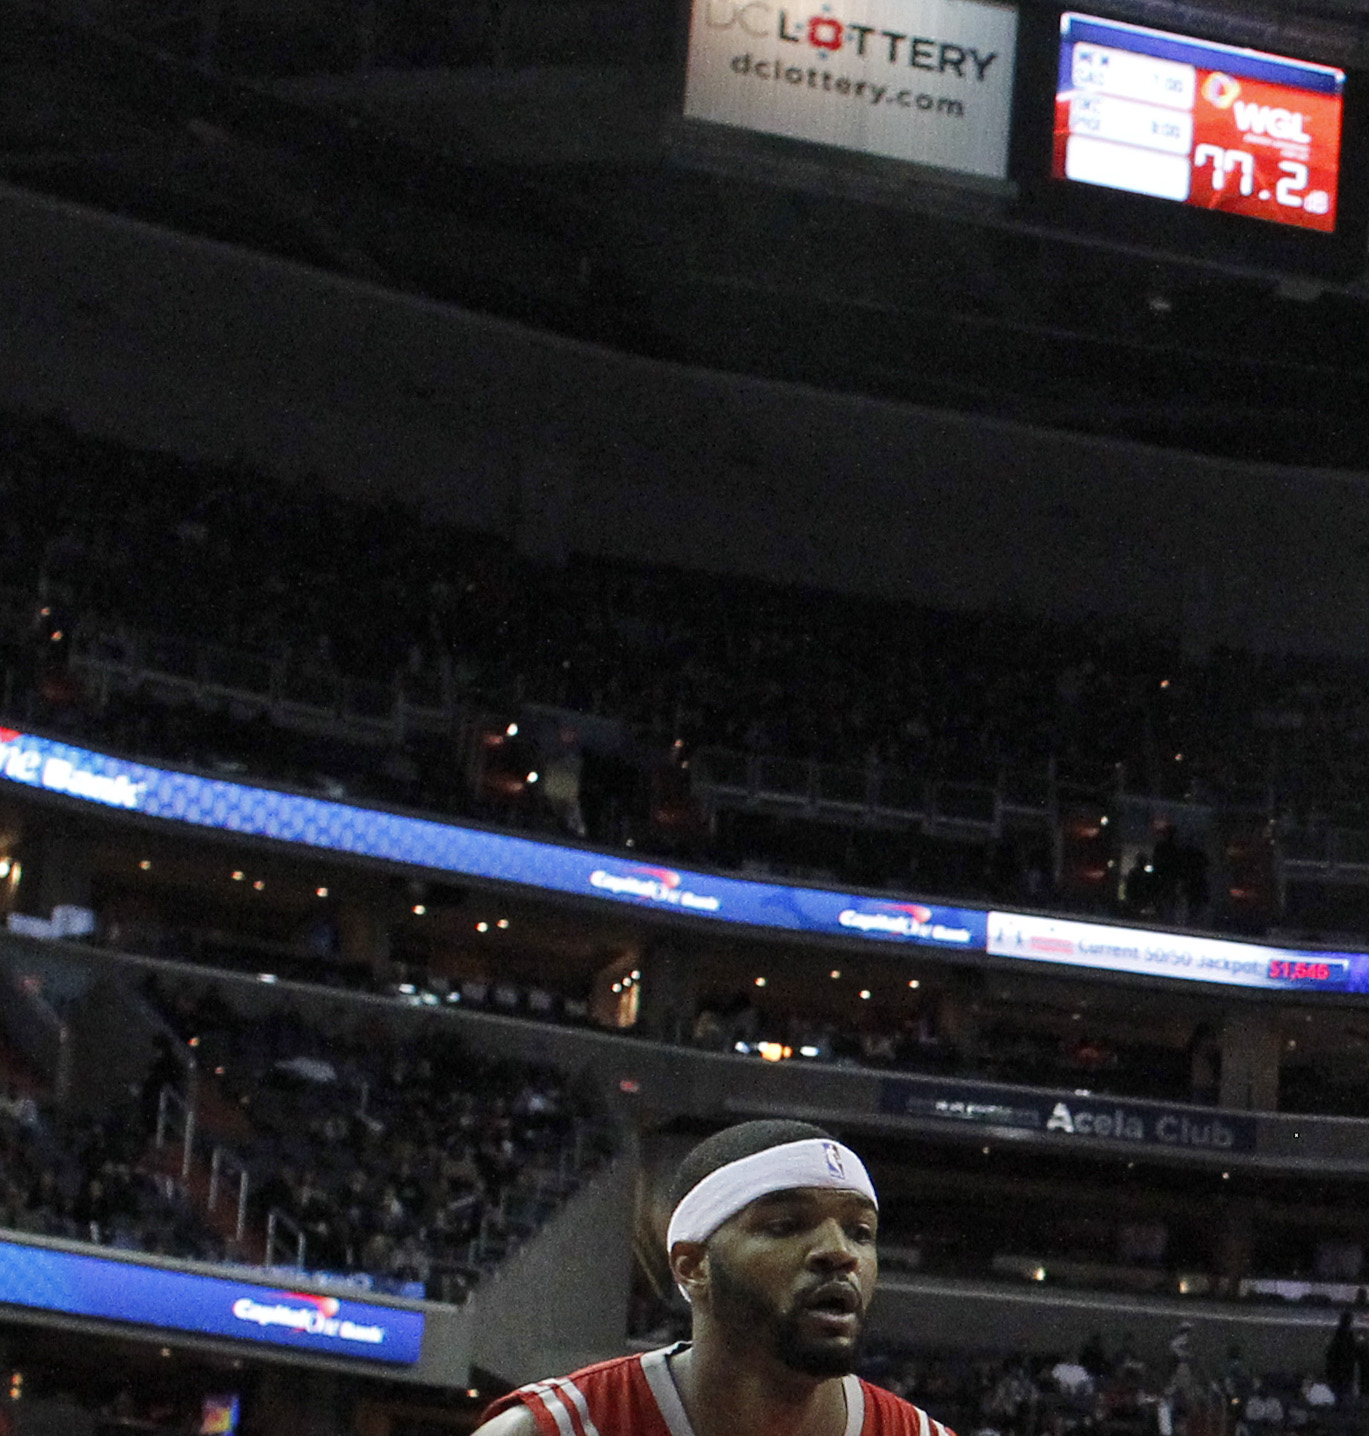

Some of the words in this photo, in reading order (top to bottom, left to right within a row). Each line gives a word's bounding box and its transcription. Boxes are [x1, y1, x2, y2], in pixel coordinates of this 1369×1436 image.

[777, 8, 998, 83] LOTTERY
[730, 53, 965, 117] dclottery.com
[1233, 100, 1312, 144] WGL
[1194, 143, 1310, 207] 77.2
[1078, 937, 1140, 961] Current
[1047, 1102, 1144, 1140] Acela
[1154, 1115, 1234, 1147] Club
